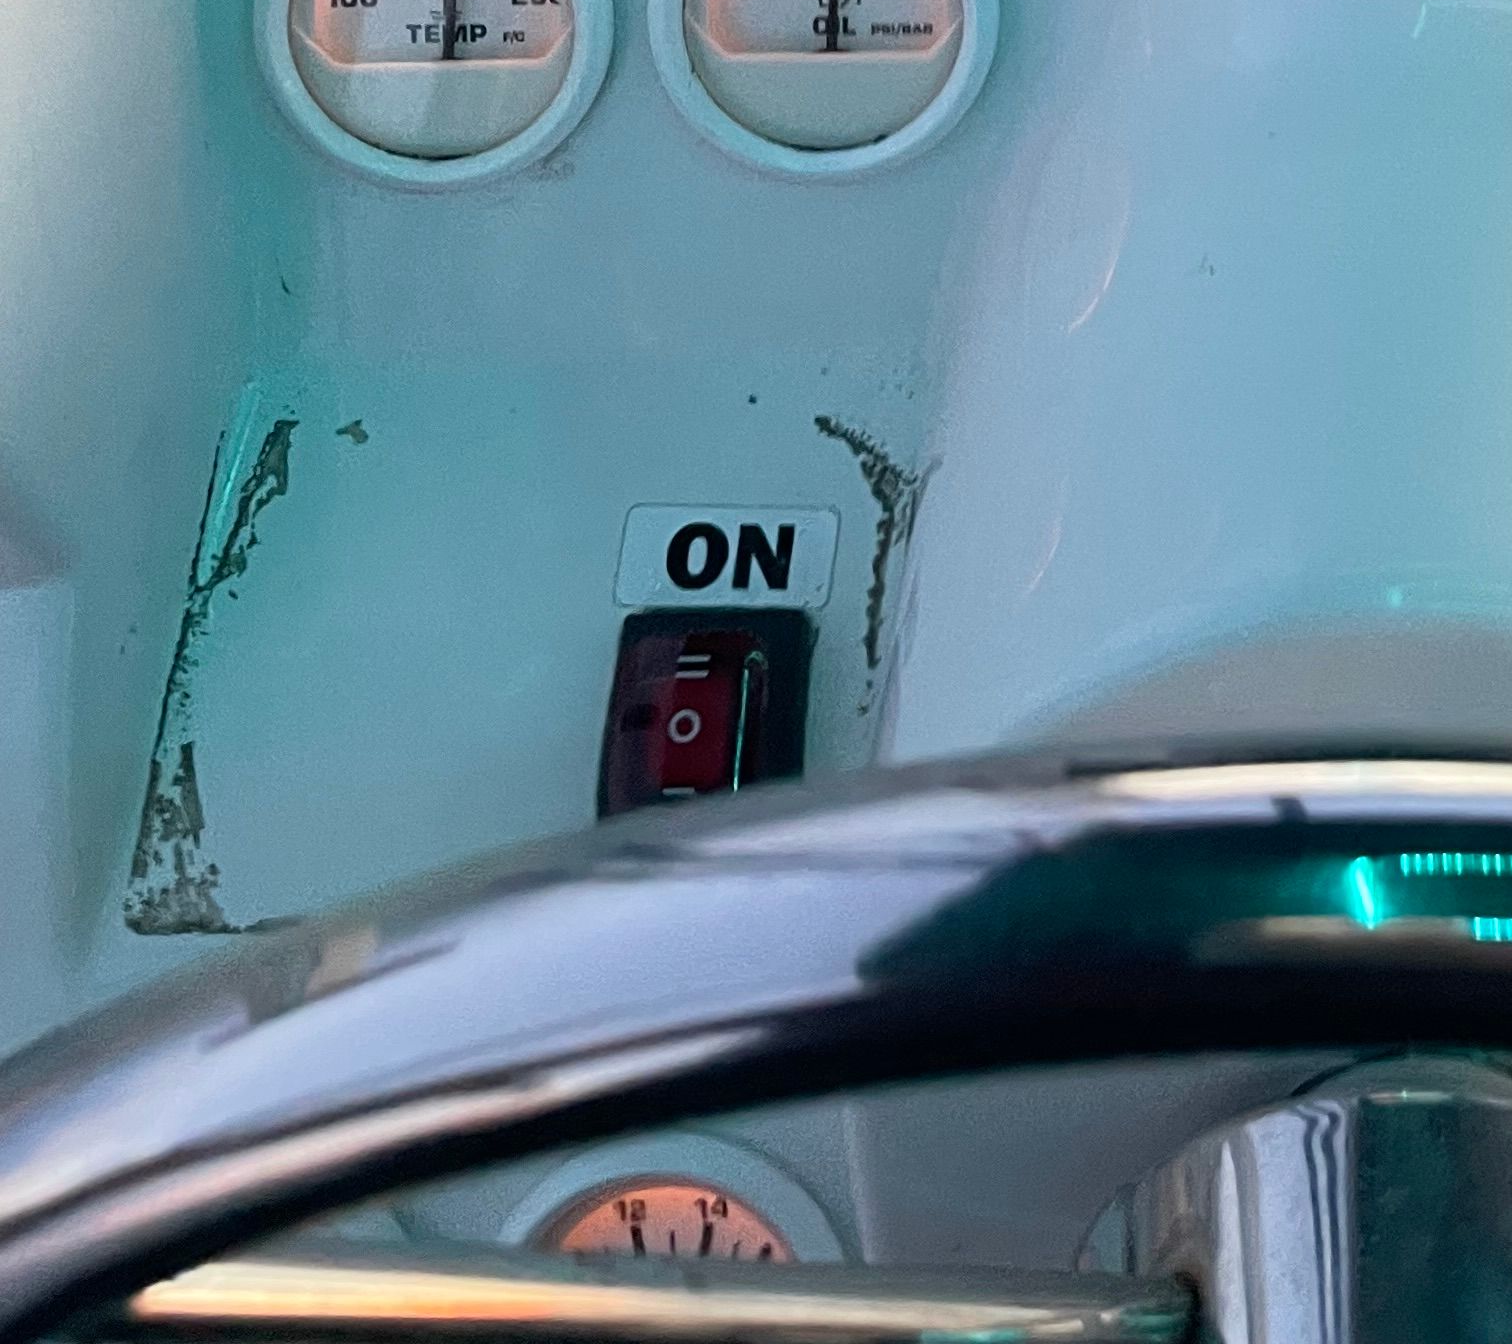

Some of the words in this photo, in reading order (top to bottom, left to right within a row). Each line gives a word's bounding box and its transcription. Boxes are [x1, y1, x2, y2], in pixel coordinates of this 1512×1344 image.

[405, 23, 488, 44] TEMP
[813, 16, 857, 35] OL
[666, 521, 796, 590] ON
